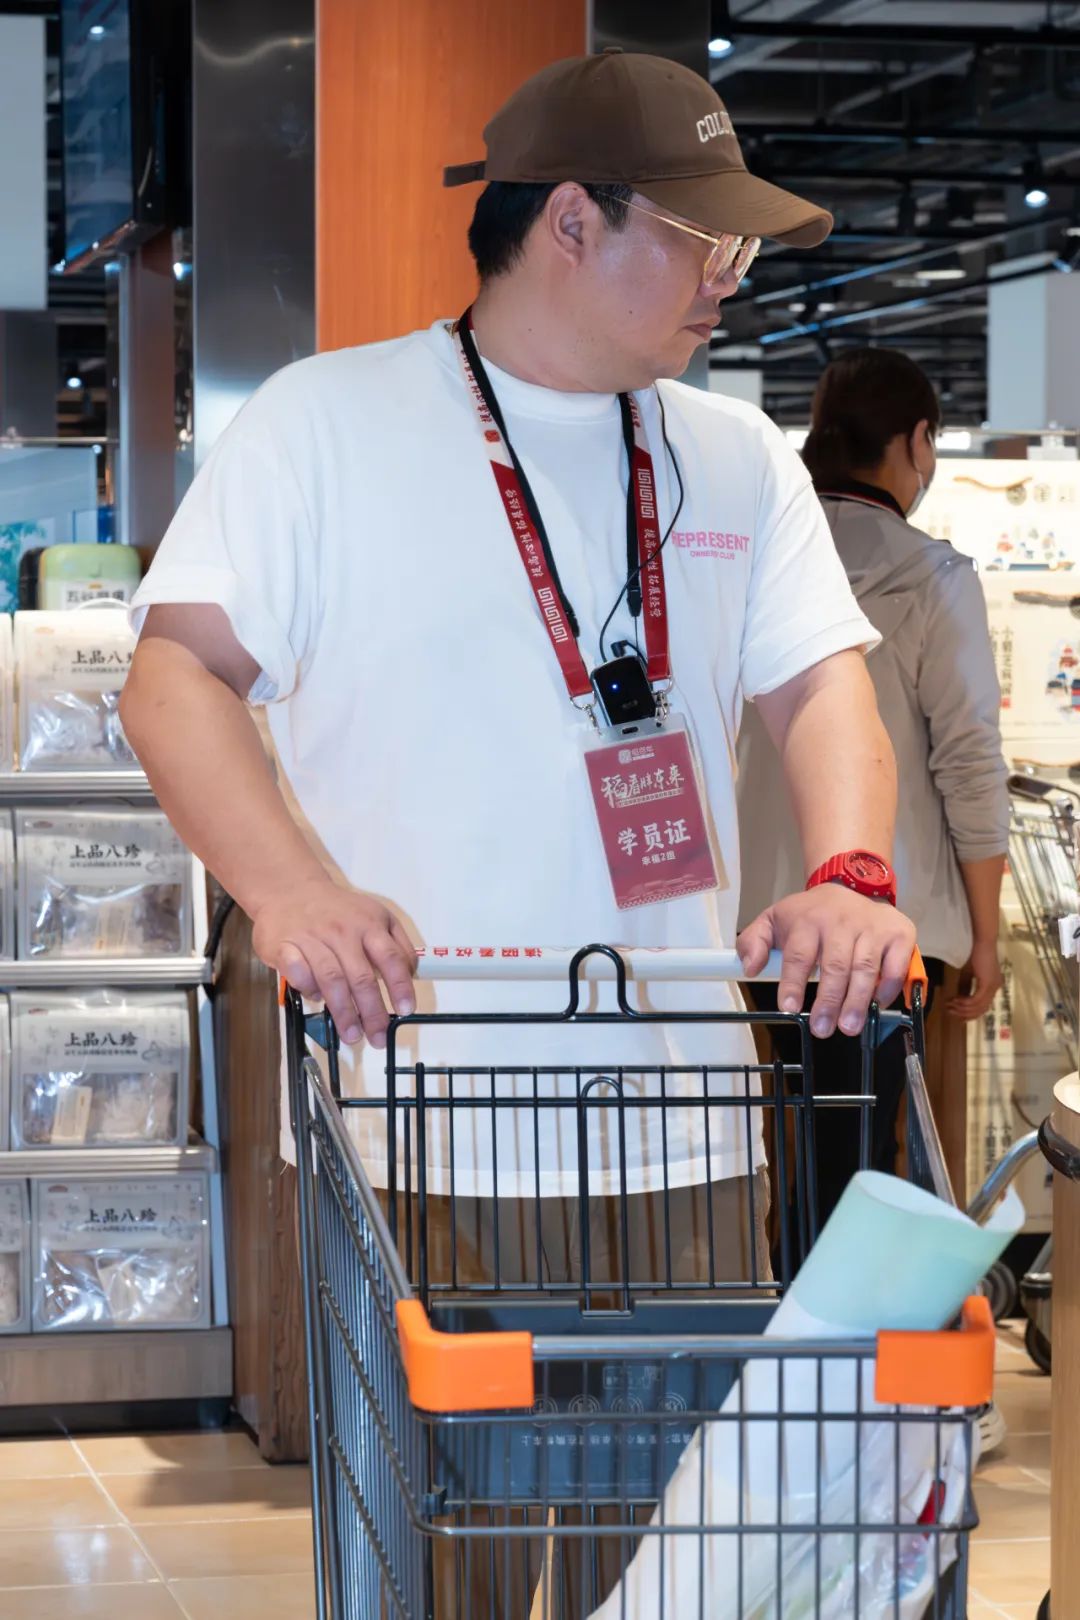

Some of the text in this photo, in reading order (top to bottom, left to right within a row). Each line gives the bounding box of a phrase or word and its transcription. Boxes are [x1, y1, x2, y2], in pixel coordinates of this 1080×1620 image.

[617, 819, 692, 856] 学员证
[70, 843, 142, 860] 上品八珍
[64, 1031, 138, 1048] 上品八珍
[84, 1207, 158, 1224] 上品八珍
